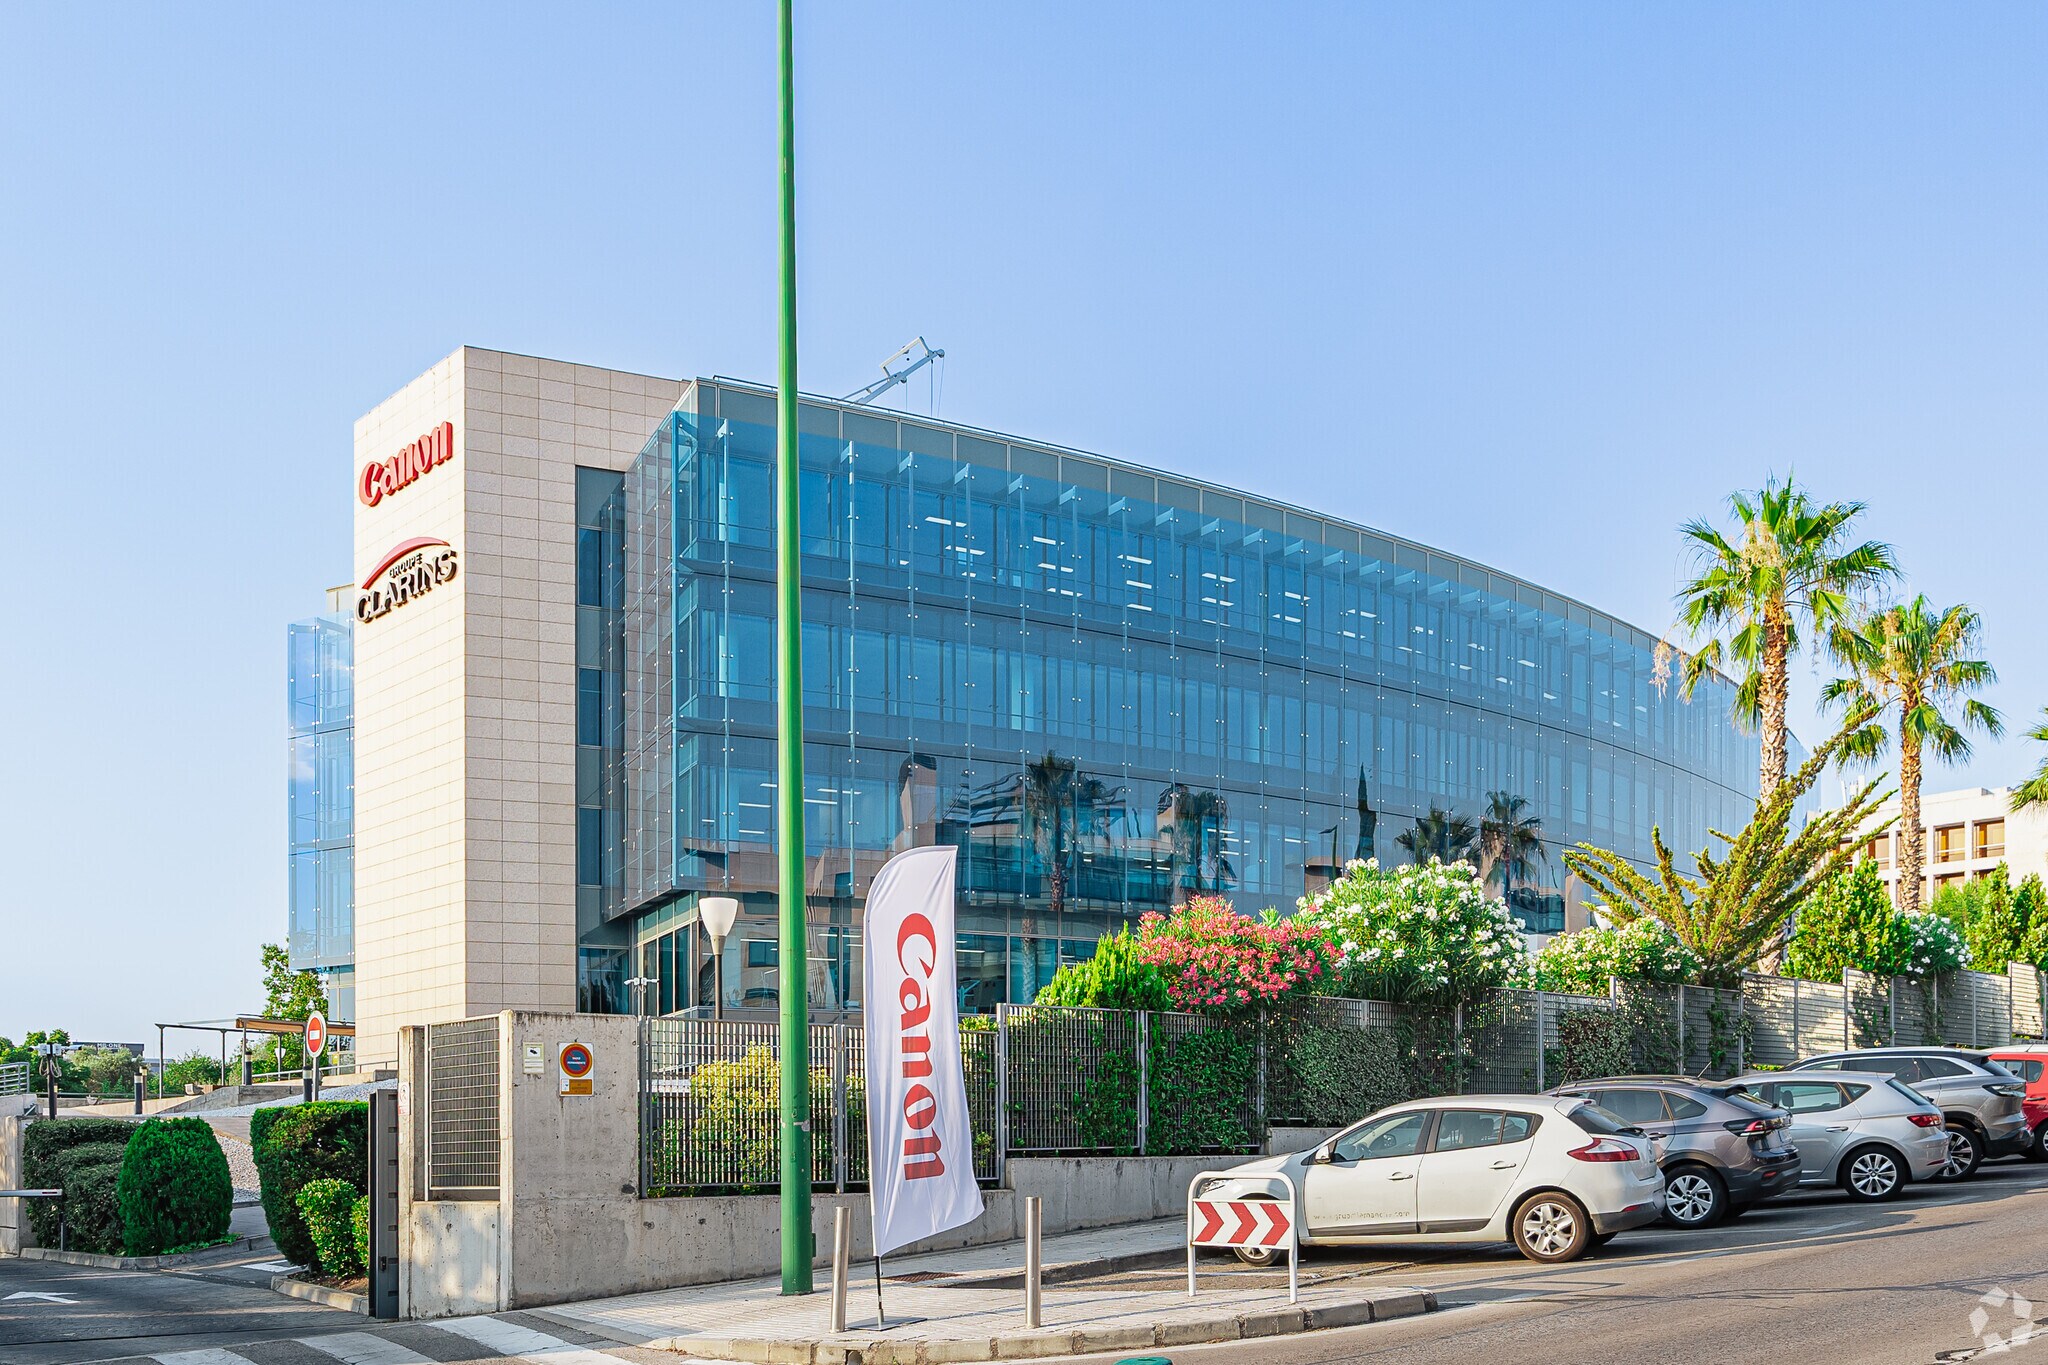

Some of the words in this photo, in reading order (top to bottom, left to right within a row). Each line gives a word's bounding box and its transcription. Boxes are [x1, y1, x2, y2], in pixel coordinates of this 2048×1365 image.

[359, 421, 453, 507] Canon
[356, 549, 457, 624] CLARINS
[389, 553, 423, 579] GROUPE
[896, 912, 945, 1181] Canon
